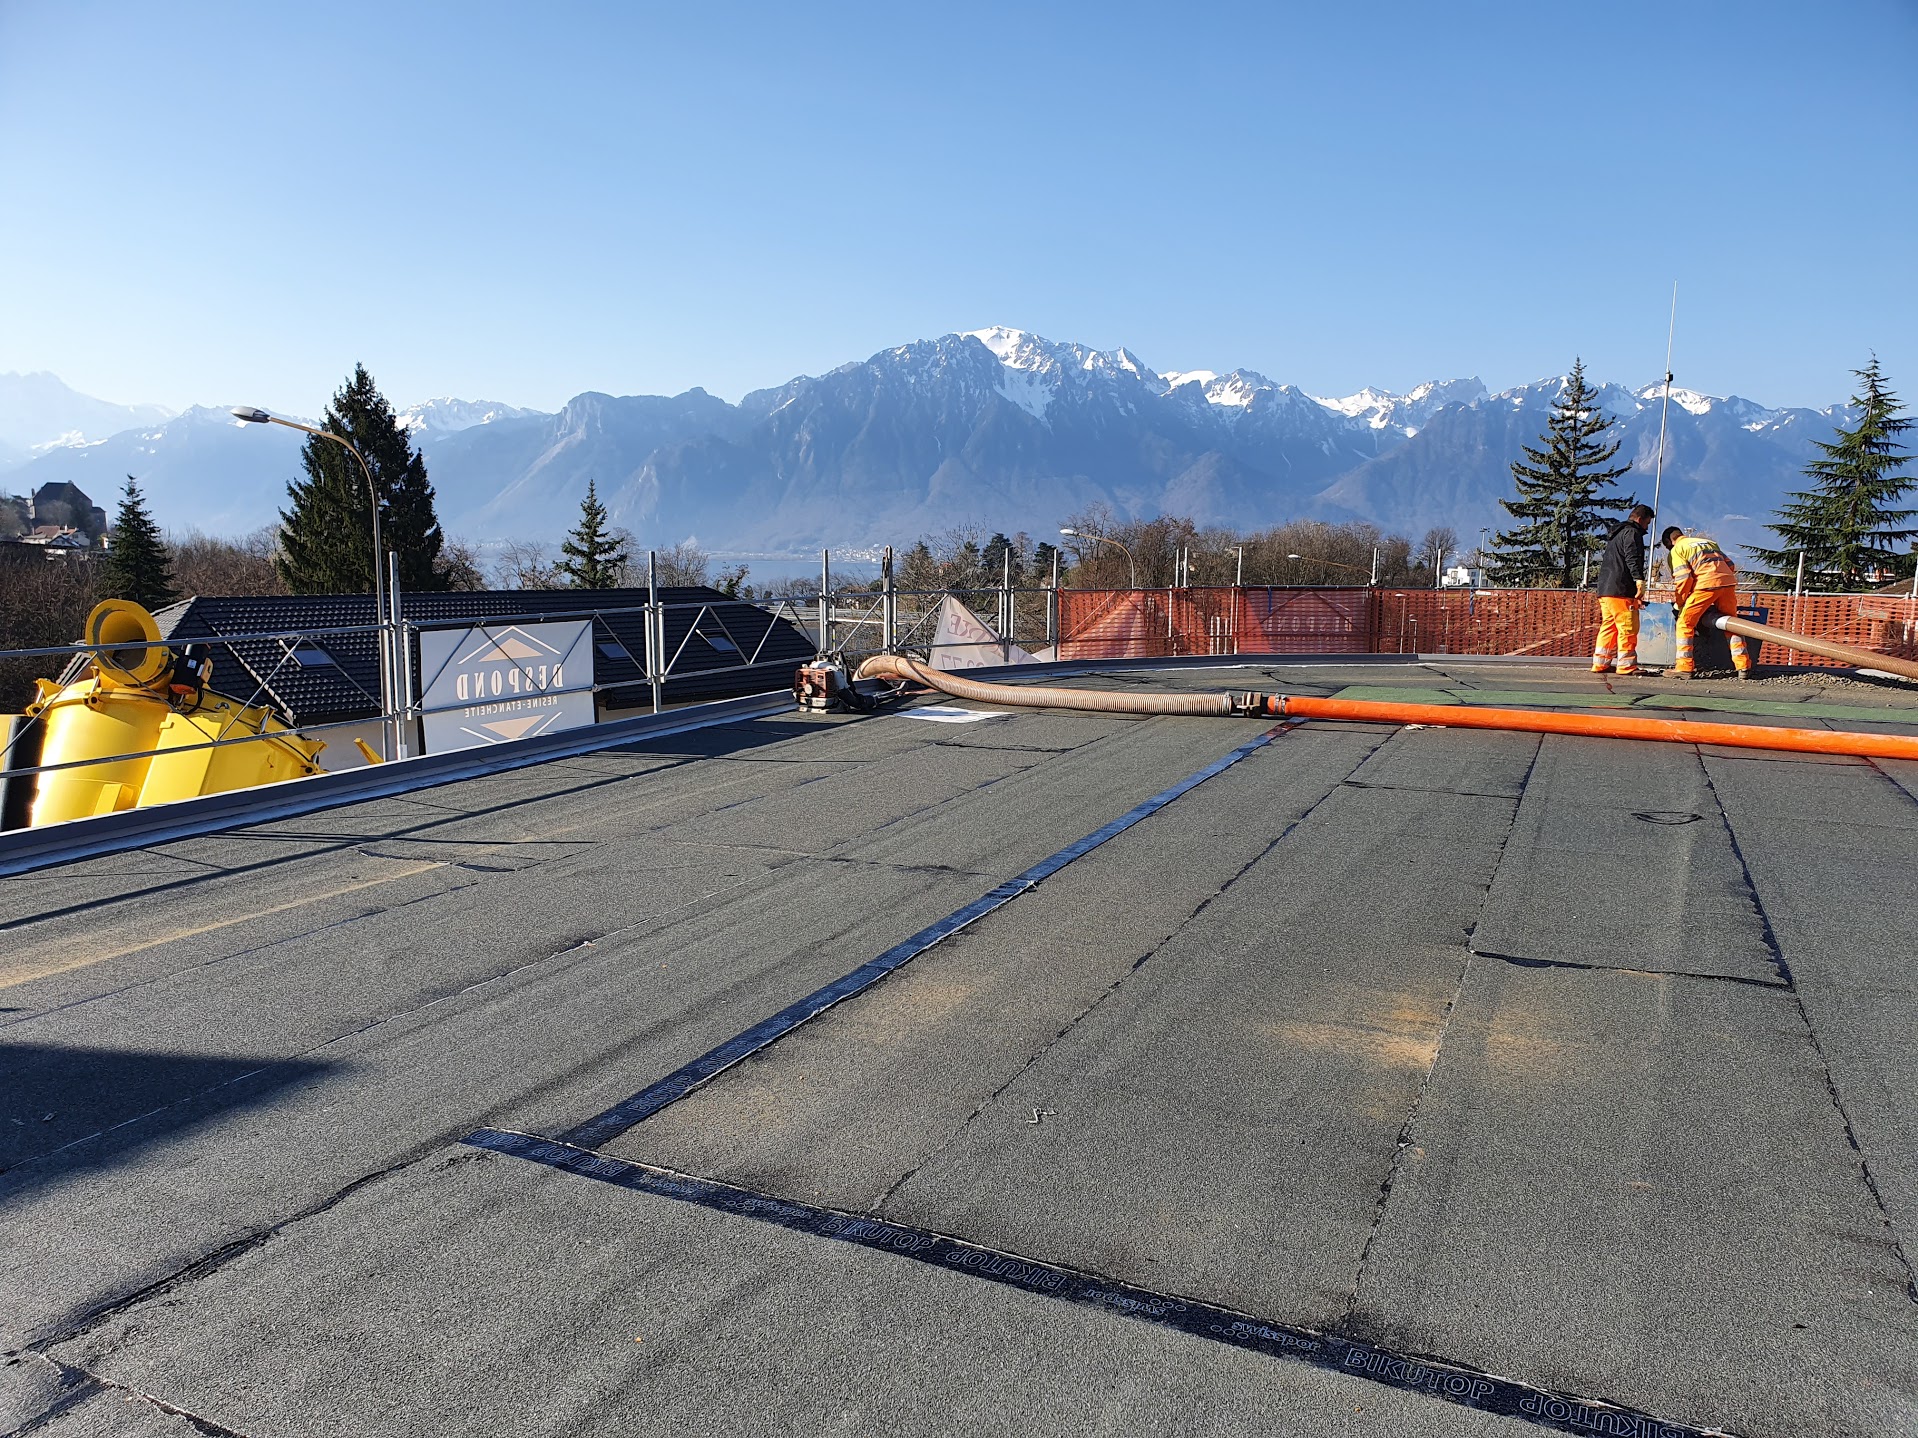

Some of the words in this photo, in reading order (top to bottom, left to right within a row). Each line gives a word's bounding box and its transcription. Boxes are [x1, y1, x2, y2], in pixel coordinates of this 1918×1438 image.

[530, 1145, 629, 1177] BIKUTOP
[821, 1215, 936, 1252] BIKUTOP
[945, 1248, 1067, 1290] BIKUTOP
[1085, 1287, 1168, 1316] swisspor
[1231, 1320, 1321, 1352] swisspor
[1344, 1347, 1494, 1400] BIKUTOP
